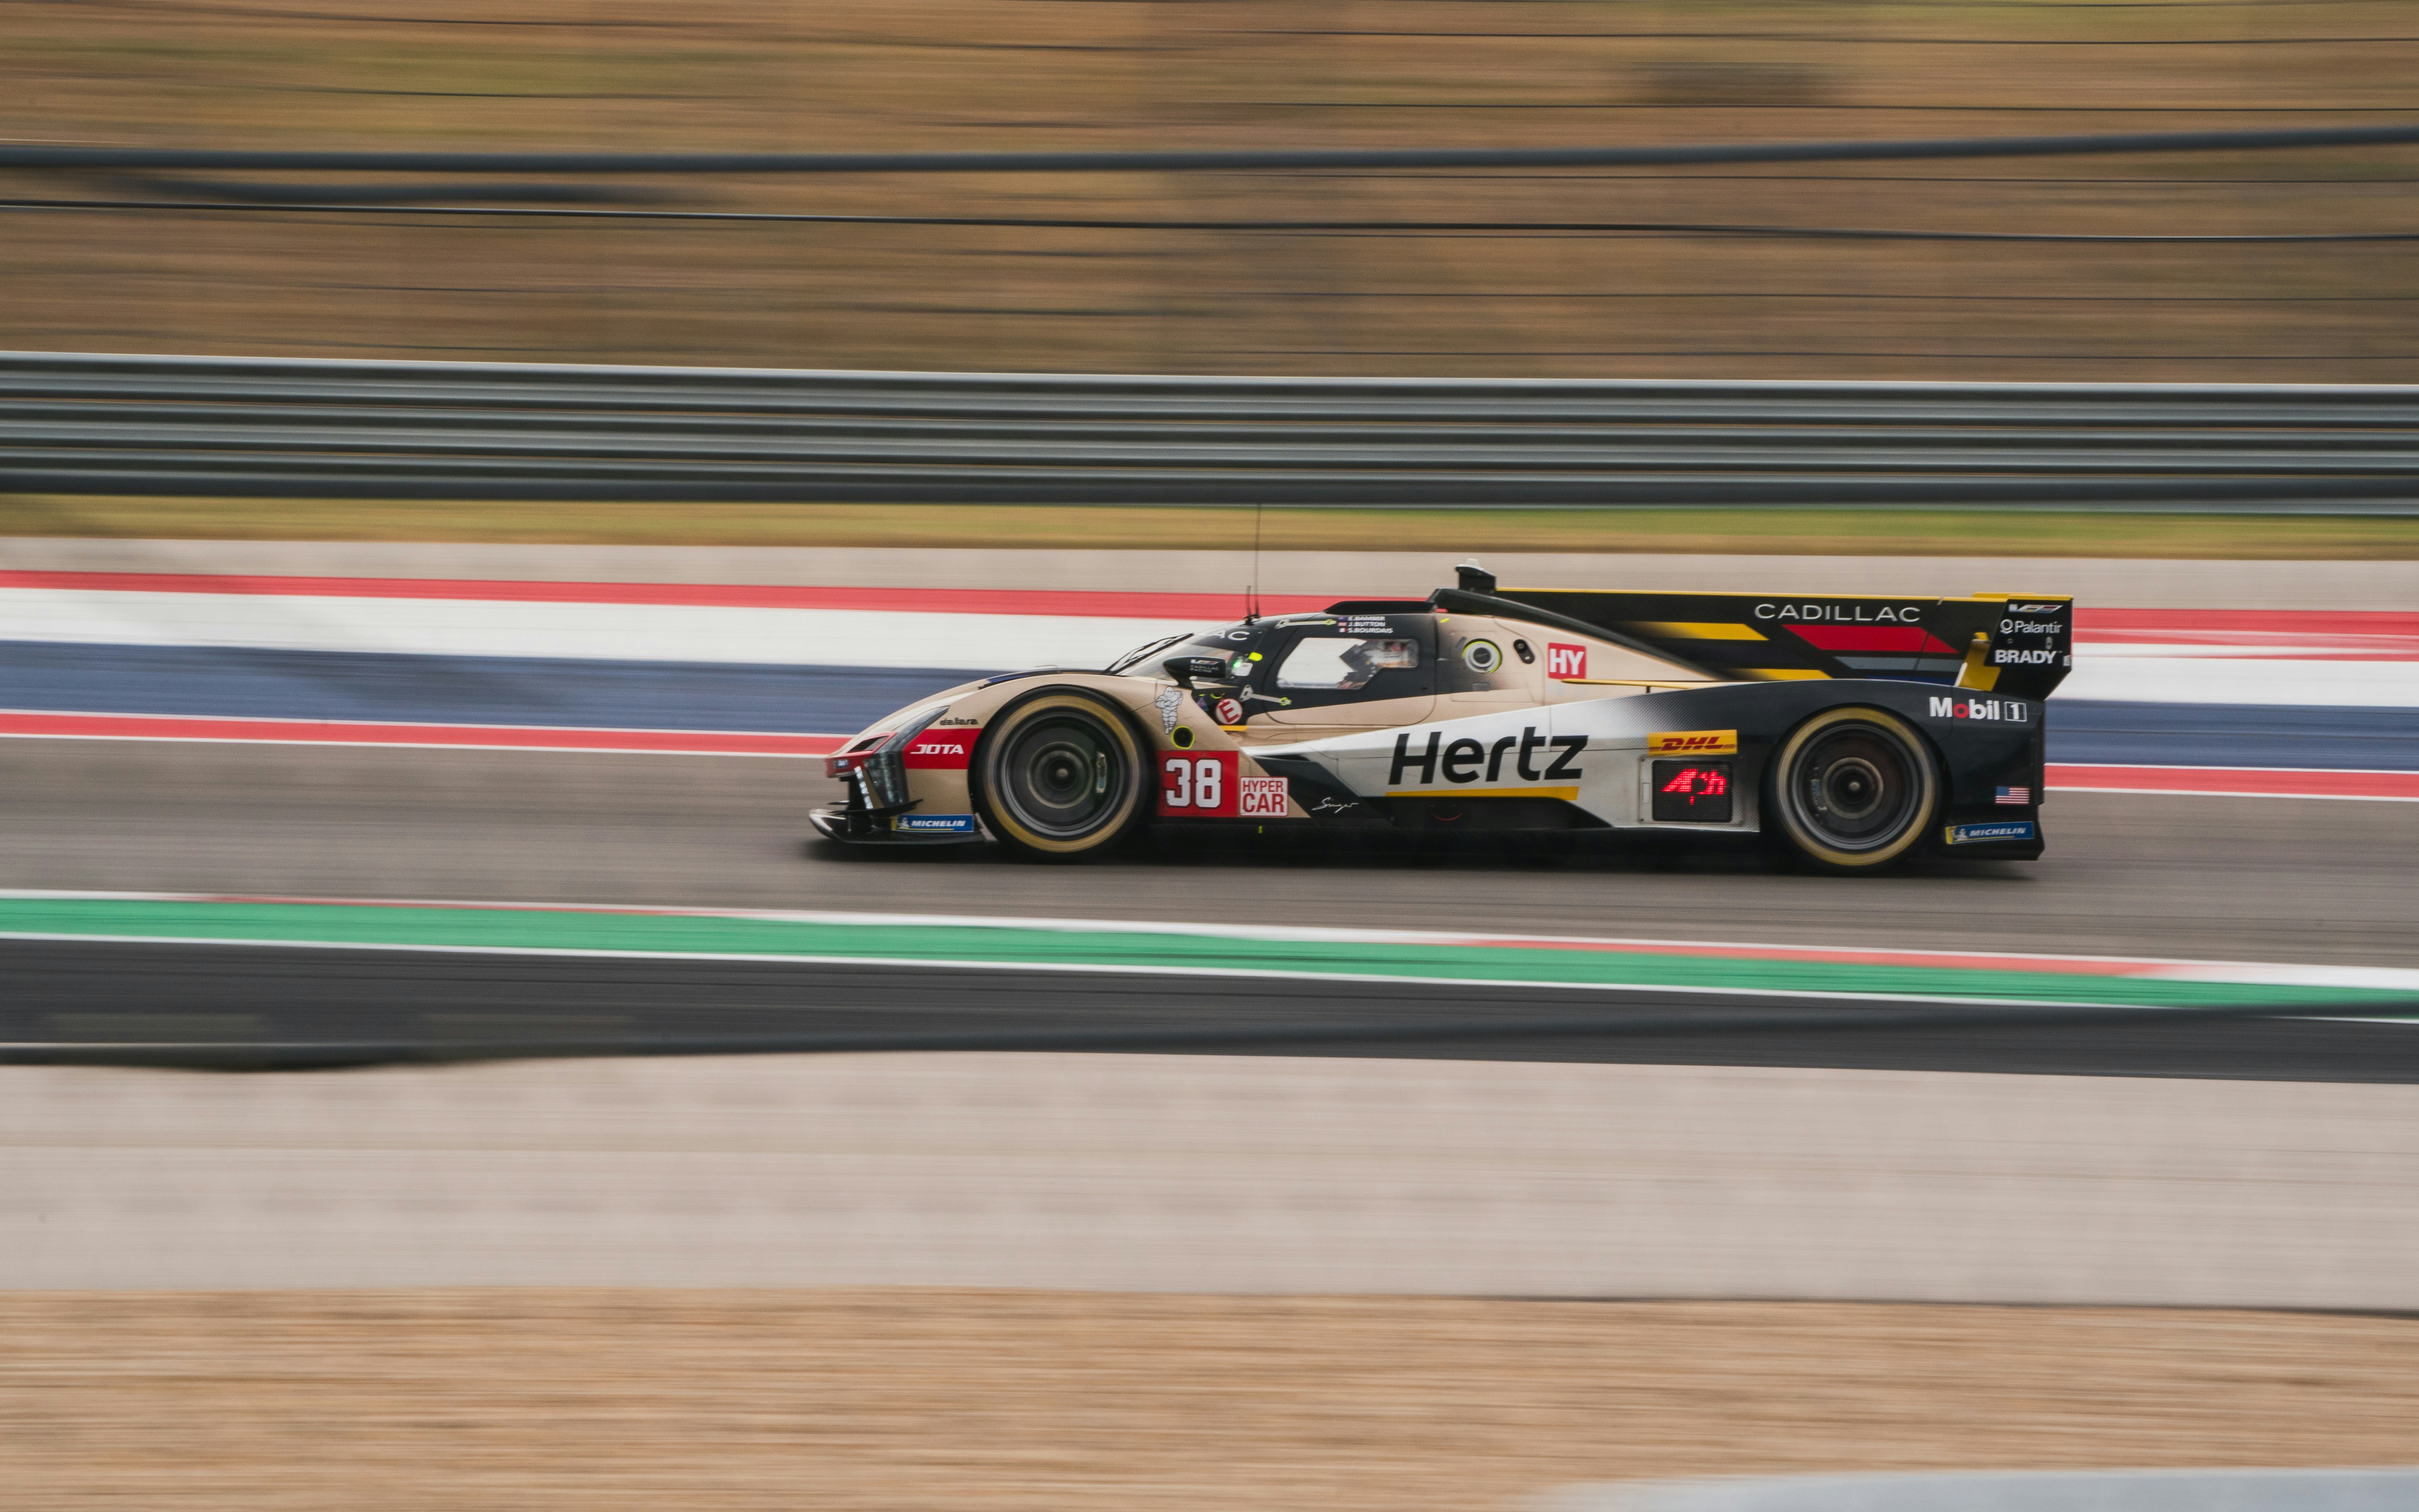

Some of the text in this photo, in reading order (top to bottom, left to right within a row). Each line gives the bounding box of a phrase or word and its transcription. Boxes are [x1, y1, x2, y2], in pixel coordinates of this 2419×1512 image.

[1754, 603, 1920, 622] CADILLAC
[2015, 621, 2063, 633] Palantir
[1549, 648, 1585, 675] HY
[1994, 649, 2057, 664] BRADY
[1930, 697, 2020, 720] Mobil 1
[910, 744, 964, 754] JOTA
[1661, 736, 1724, 751] DHL
[1388, 726, 1589, 785] Hertz
[1165, 759, 1222, 808] 38
[1243, 780, 1284, 792] HYPER
[1243, 792, 1285, 813] CAR
[1970, 827, 2026, 837] MICHELIN
